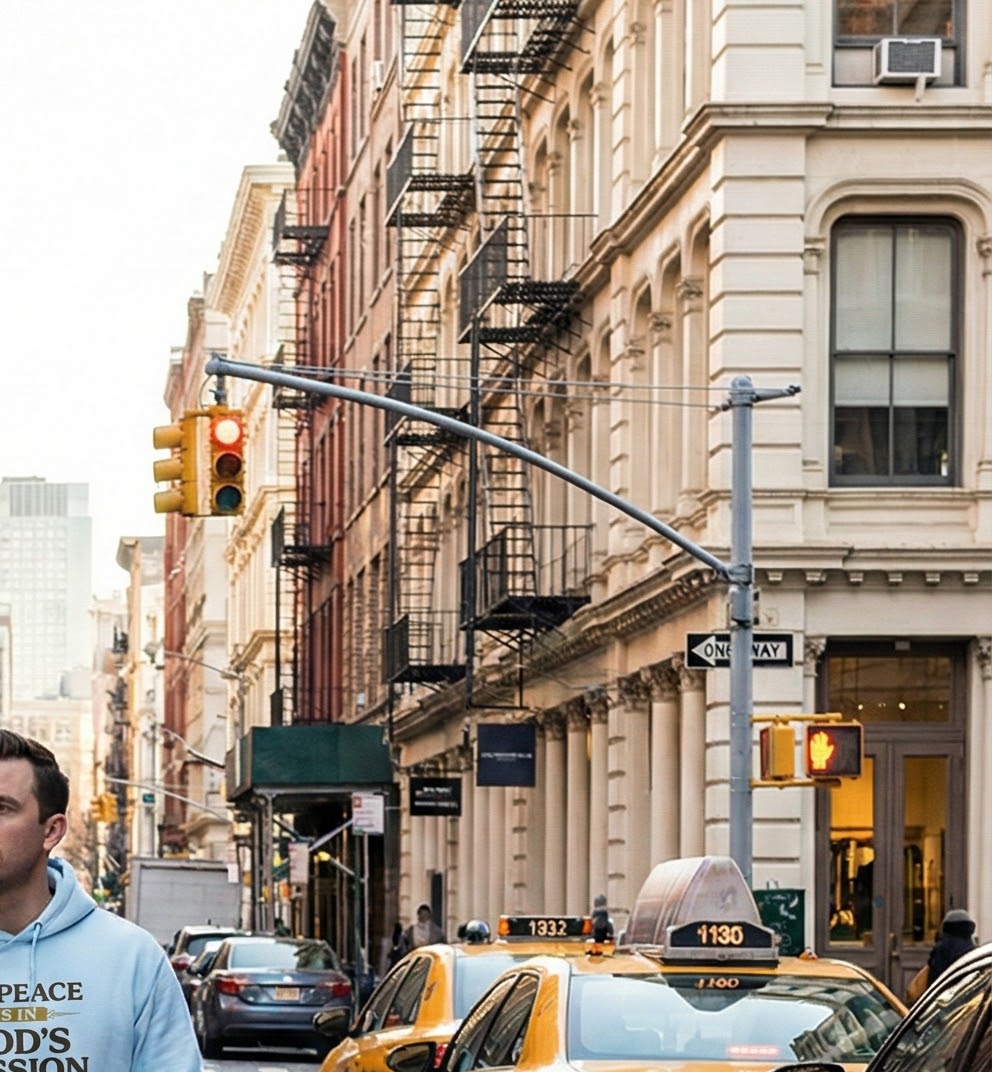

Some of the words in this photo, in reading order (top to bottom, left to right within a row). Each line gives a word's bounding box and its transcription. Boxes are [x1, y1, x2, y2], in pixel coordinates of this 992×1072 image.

[529, 920, 567, 936] 1332
[697, 924, 744, 945] 1130
[17, 1008, 37, 1021] IN
